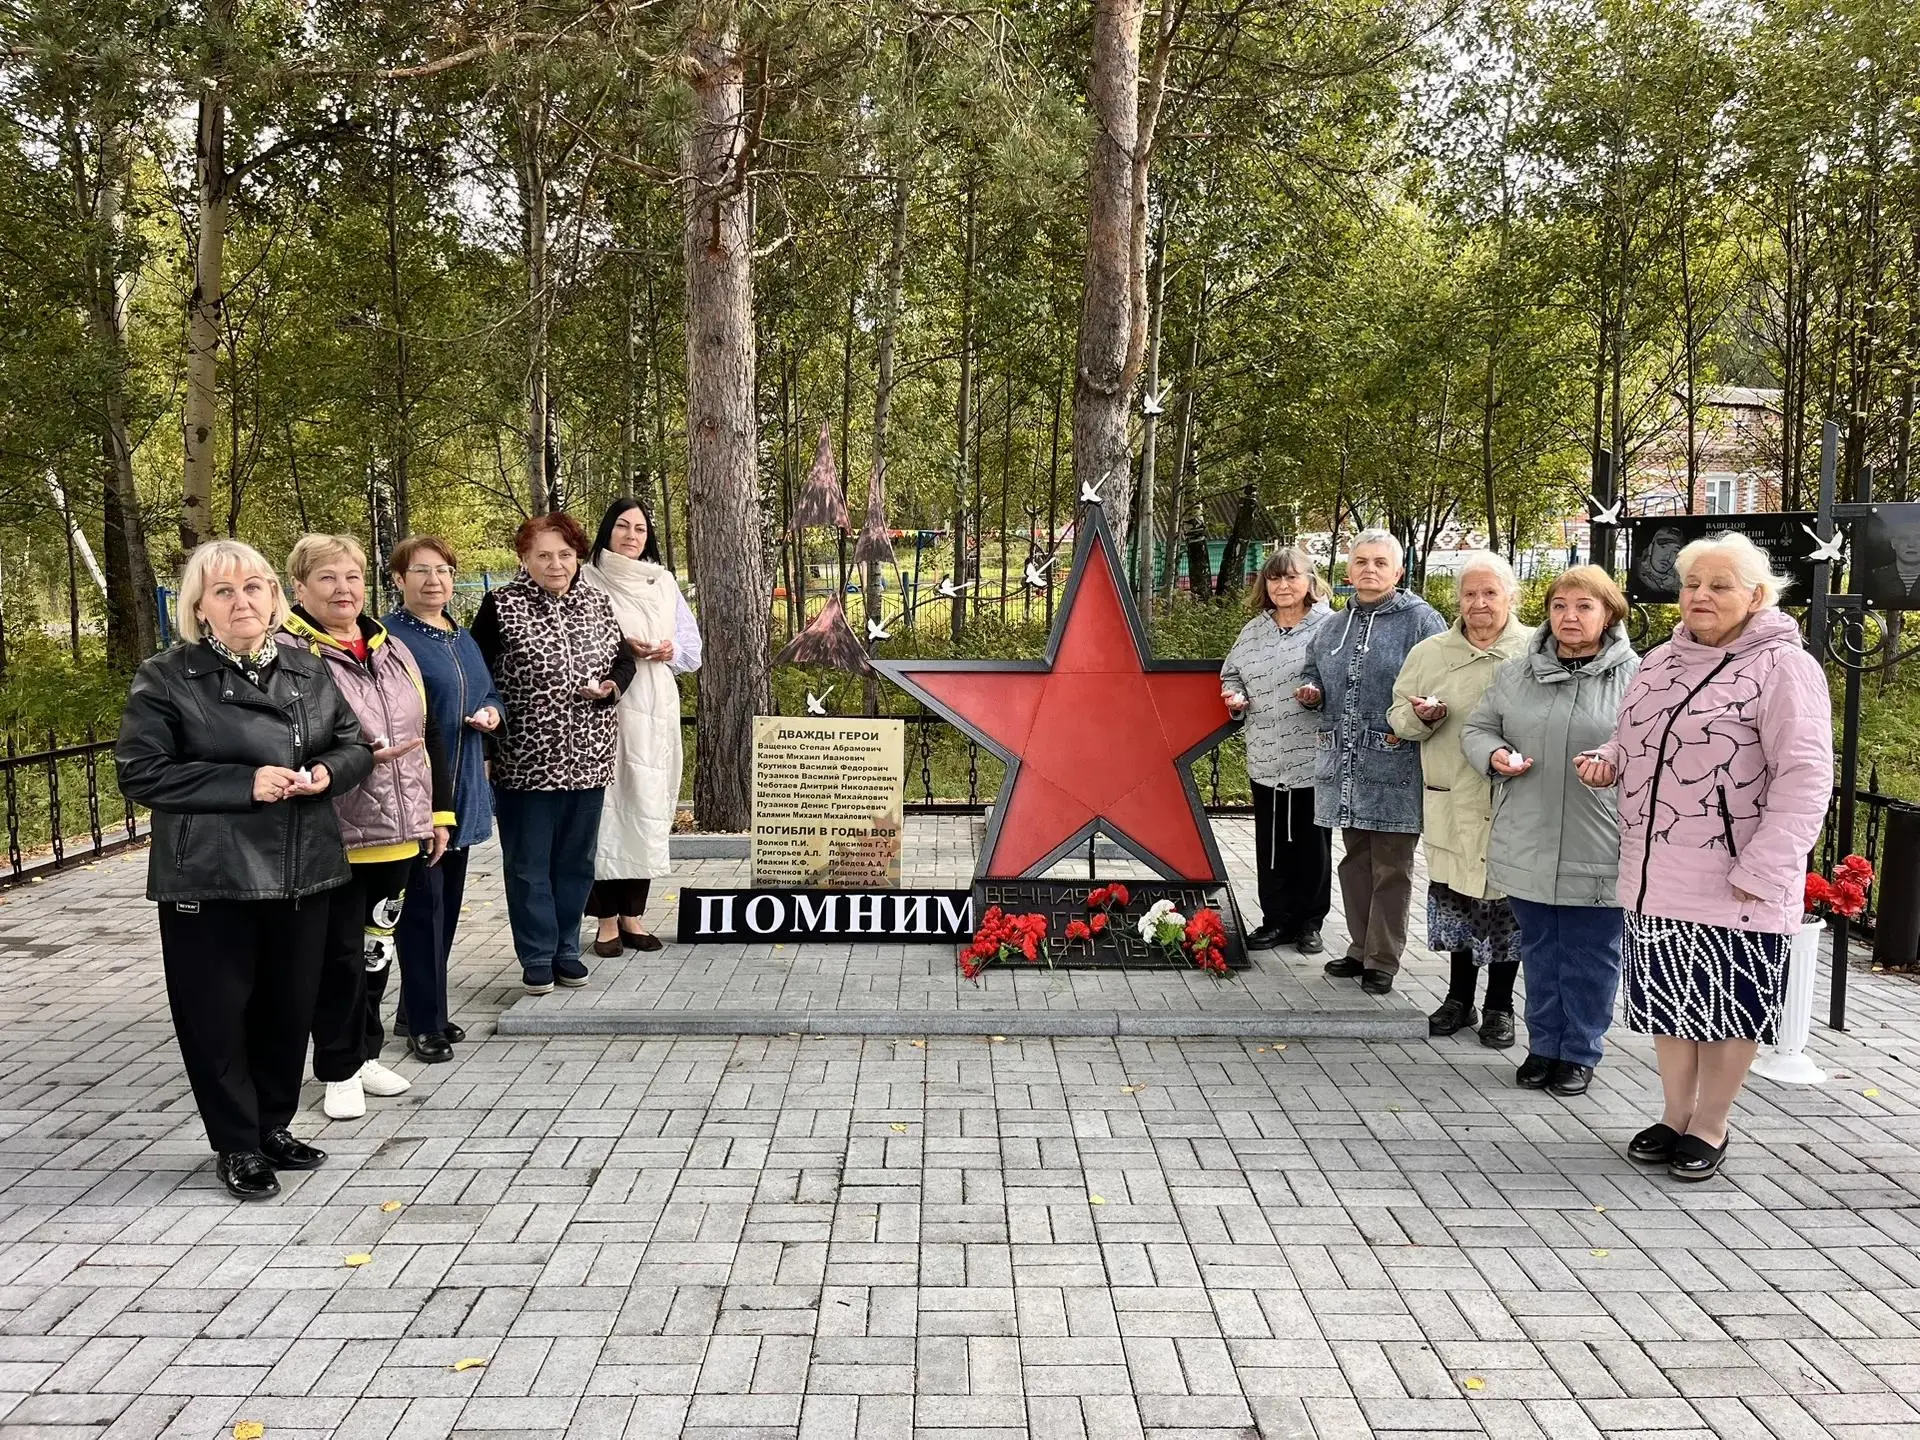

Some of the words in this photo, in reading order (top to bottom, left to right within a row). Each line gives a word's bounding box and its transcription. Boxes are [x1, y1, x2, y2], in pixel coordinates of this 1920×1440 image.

[778, 730, 834, 740] ДВАЖДЫ
[840, 732, 879, 740] ГЕРОИ
[840, 764, 888, 772] Федорович
[842, 774, 897, 782] Григорьевич
[757, 826, 815, 835] ПОГИБЛИ
[832, 828, 866, 837] ГОДЫ
[871, 829, 896, 837] ВОВ
[985, 886, 1092, 905] ВЕЧНАЯ
[1129, 888, 1223, 907] АМЯТЬ
[695, 894, 973, 934] ПОМНИМ
